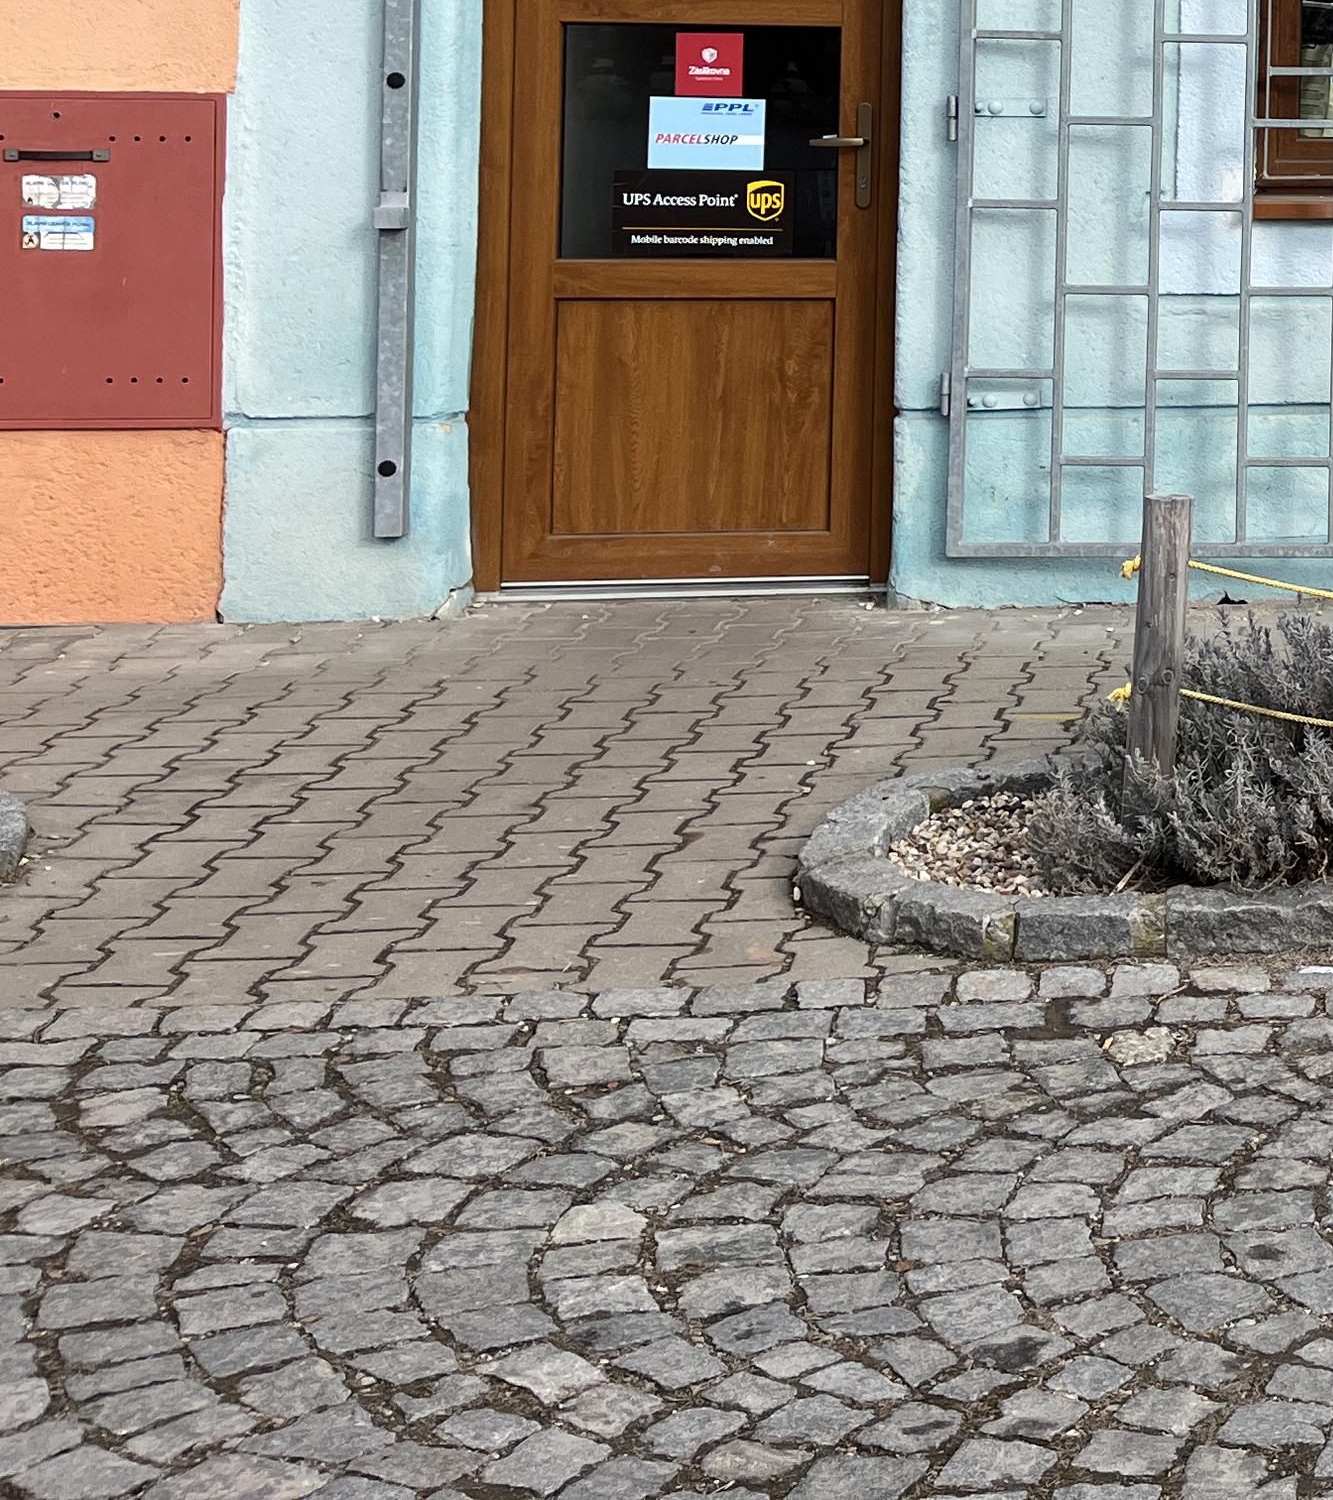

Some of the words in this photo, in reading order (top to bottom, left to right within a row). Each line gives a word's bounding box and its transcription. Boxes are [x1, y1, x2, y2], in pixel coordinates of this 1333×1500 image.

[713, 103, 754, 113] PPL
[622, 193, 651, 206] UPS
[652, 193, 697, 207] Access
[749, 192, 781, 215] ups
[631, 234, 662, 245] Mobile
[663, 235, 698, 245] barcode
[699, 235, 738, 247] shipping
[738, 237, 774, 246] enabled
